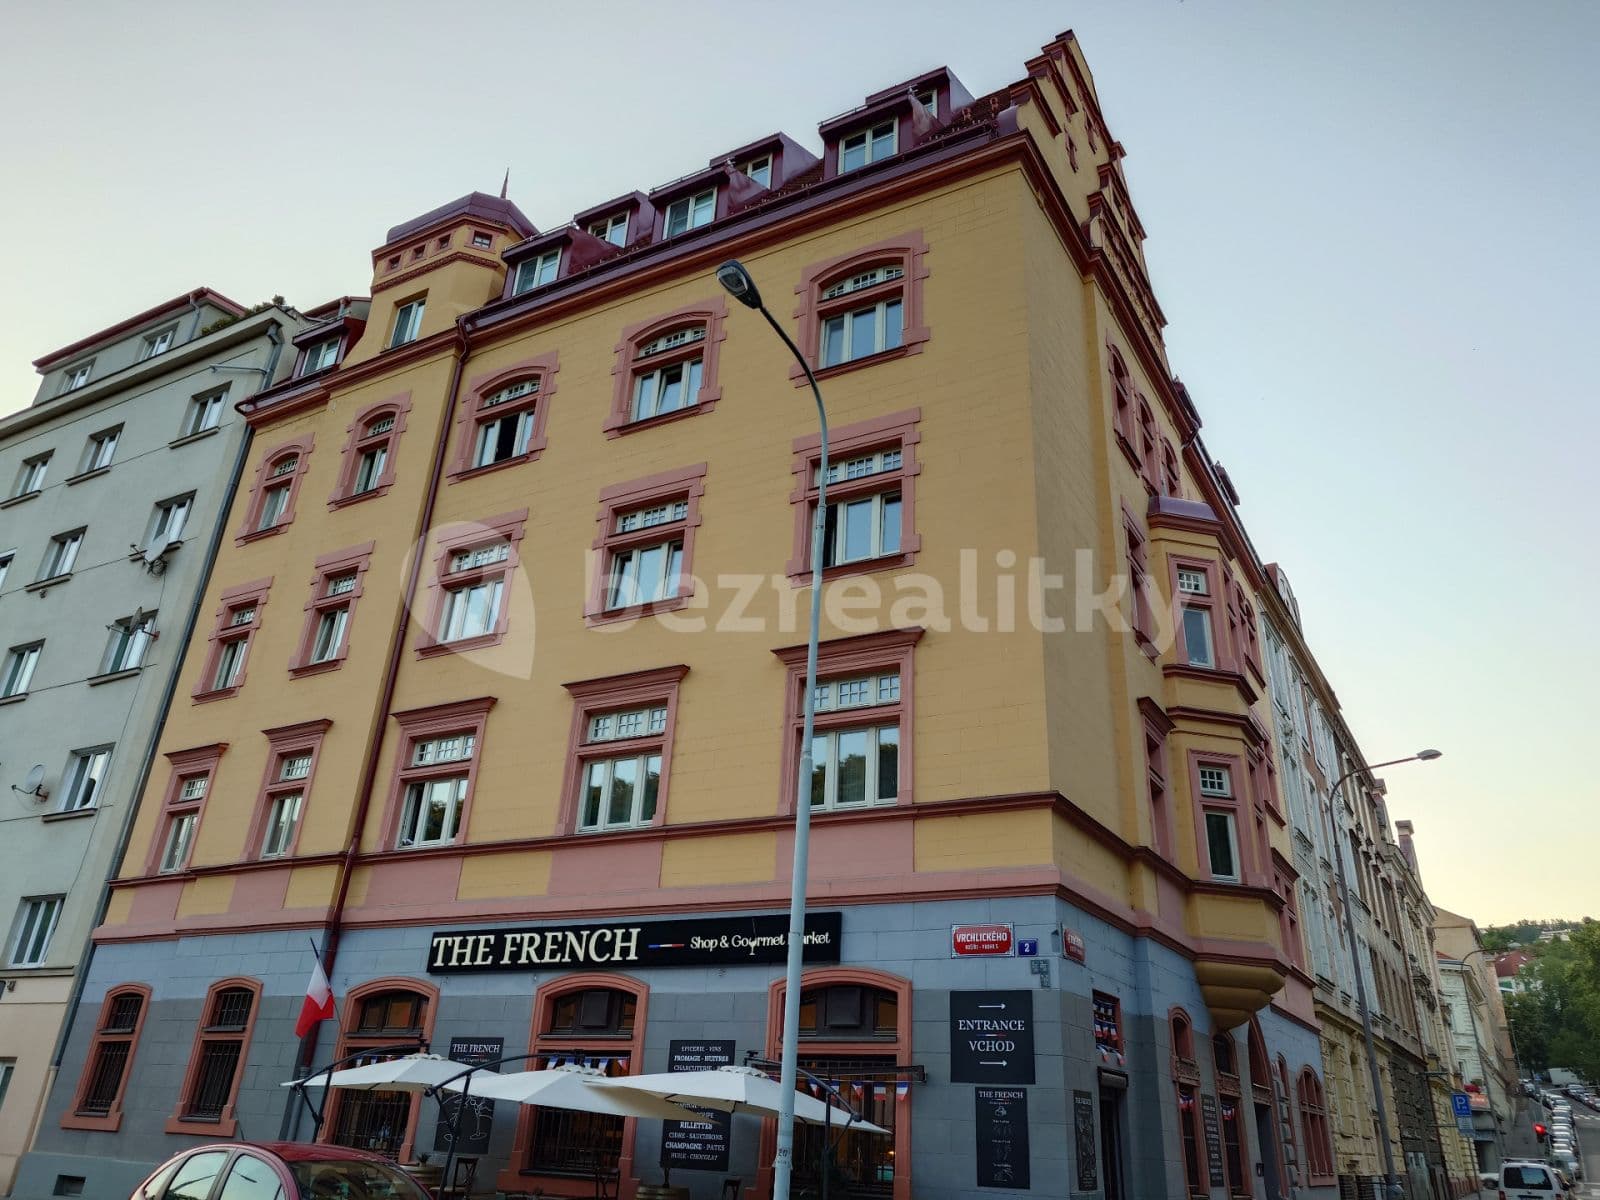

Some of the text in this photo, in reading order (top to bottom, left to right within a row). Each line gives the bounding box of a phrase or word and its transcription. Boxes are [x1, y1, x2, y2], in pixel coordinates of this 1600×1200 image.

[956, 931, 1008, 943] VRCHLICKÉHO
[433, 928, 641, 967] THE FRENCH
[690, 935, 718, 952] Shop
[720, 935, 729, 948] &
[732, 934, 786, 955] Gourmet
[1024, 943, 1030, 952] 2
[958, 1019, 1025, 1031] ENTRANCE
[453, 1043, 500, 1053] THE FRENCH
[968, 1040, 1015, 1052] VCHOD
[978, 1090, 1024, 1099] THE FRENCH
[679, 1121, 713, 1130] RILLETTES
[665, 1141, 702, 1150] CHAMPAGNE
